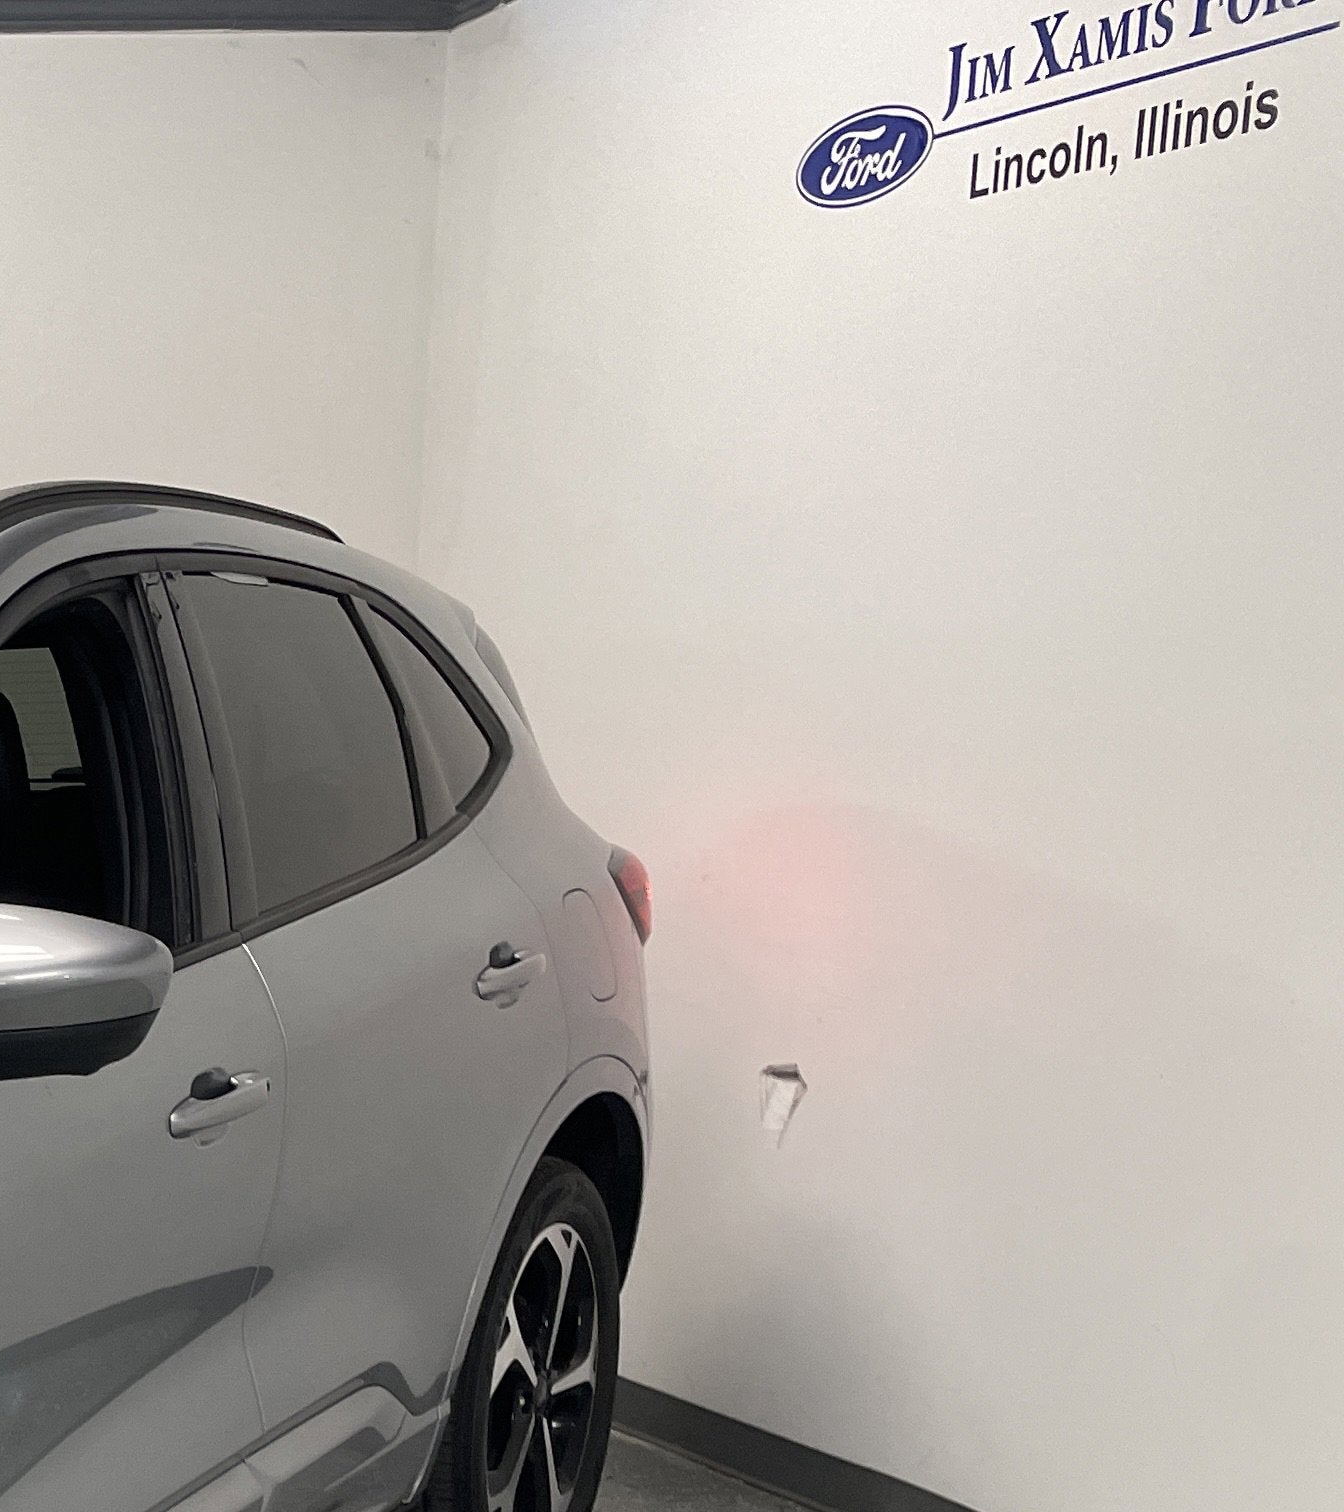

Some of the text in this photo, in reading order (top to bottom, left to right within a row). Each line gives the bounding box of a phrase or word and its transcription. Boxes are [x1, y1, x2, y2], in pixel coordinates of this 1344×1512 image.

[942, 42, 1015, 122] JIM
[1024, 0, 1175, 86] XAMIS
[820, 124, 904, 196] Ford
[969, 80, 1280, 200] Lincoln, Illinois
